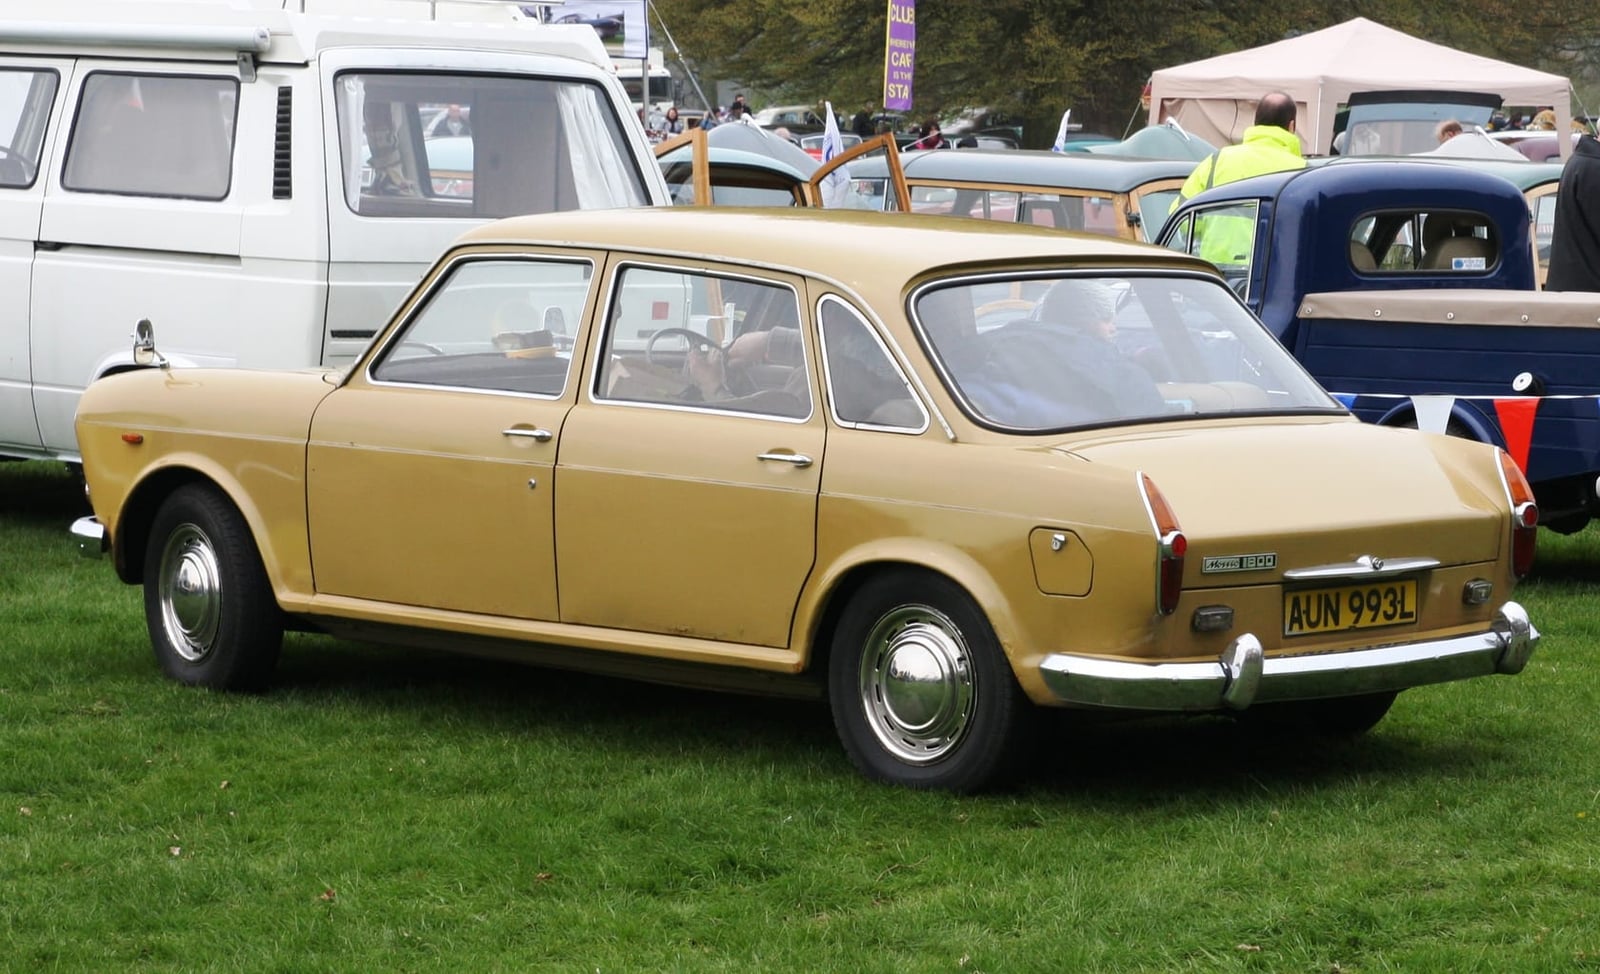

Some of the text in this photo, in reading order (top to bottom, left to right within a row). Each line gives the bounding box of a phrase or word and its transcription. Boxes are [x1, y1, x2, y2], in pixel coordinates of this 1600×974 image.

[890, 4, 915, 24] CLUB
[1242, 555, 1275, 569] 1800
[1288, 584, 1414, 632] AUN 993L
